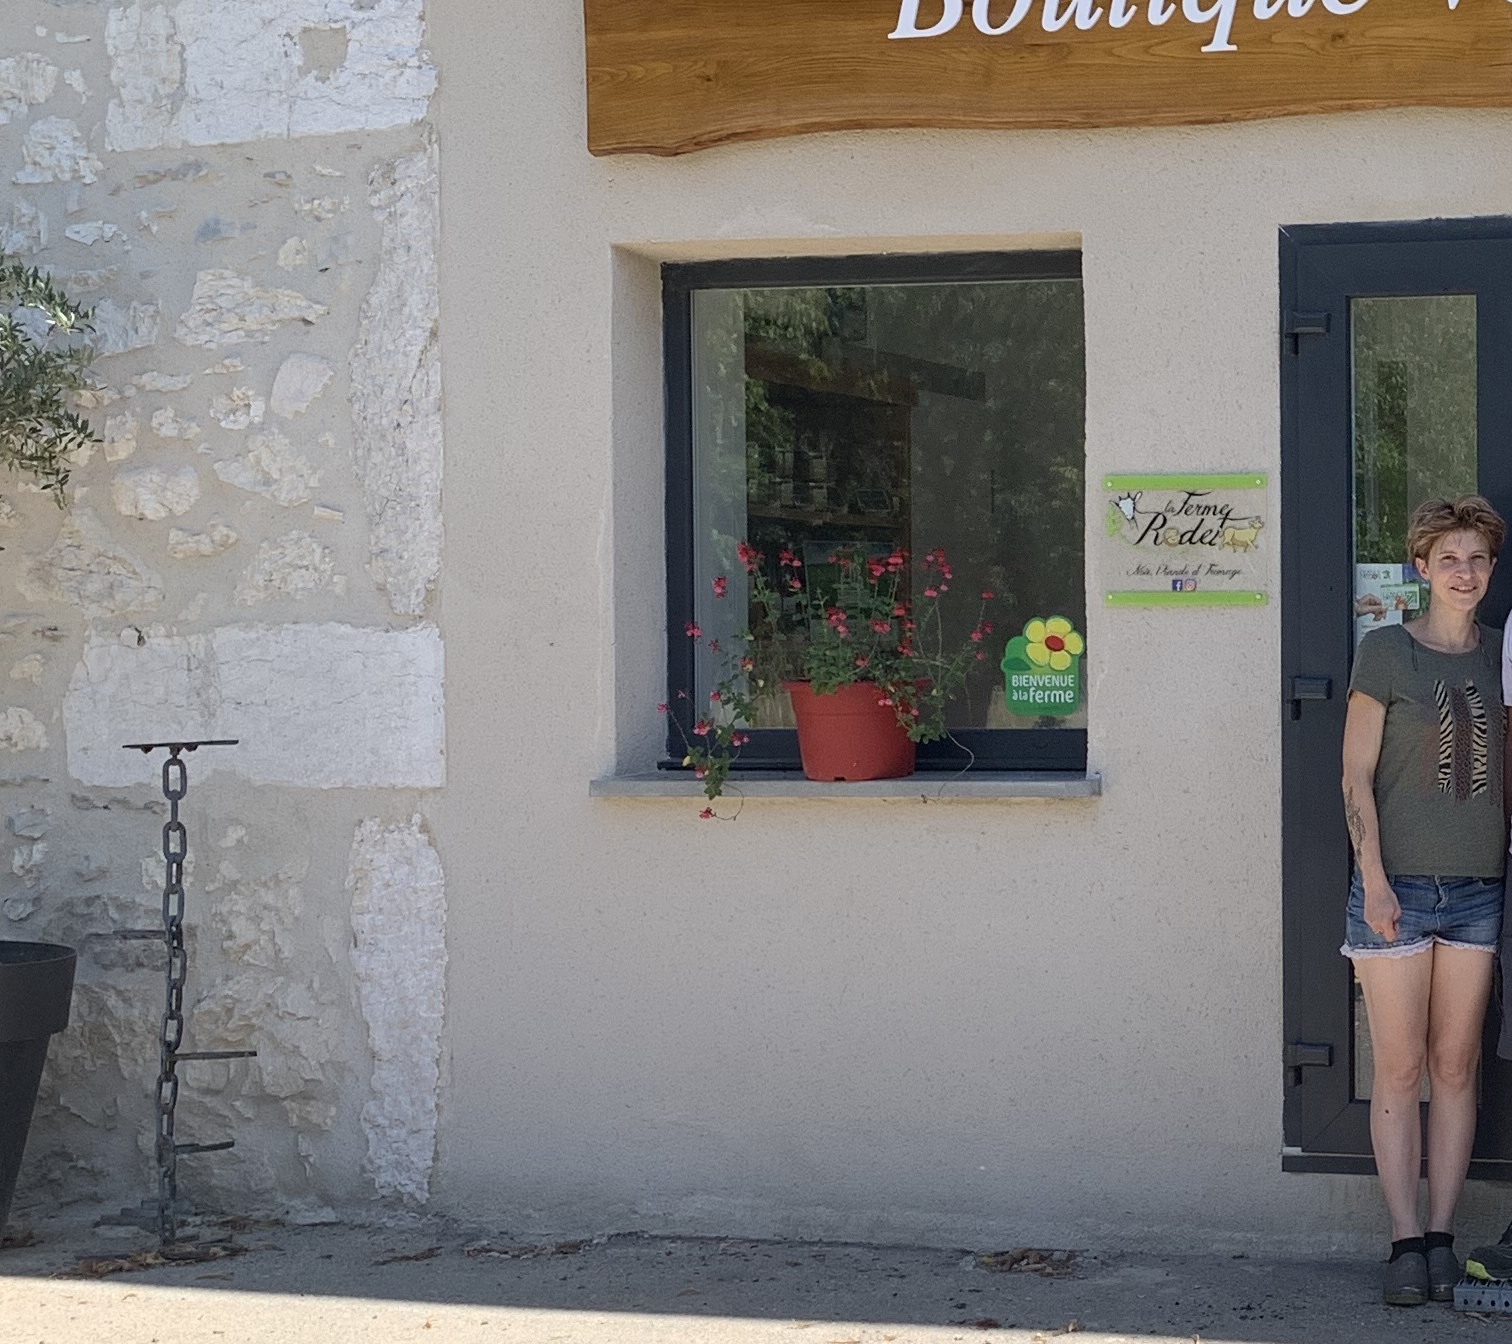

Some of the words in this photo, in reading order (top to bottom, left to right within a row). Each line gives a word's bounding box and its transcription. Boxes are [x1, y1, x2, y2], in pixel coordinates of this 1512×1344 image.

[1011, 674, 1075, 687] BIENVENUE
[1019, 690, 1029, 701] la
[1029, 687, 1074, 703] ferme
